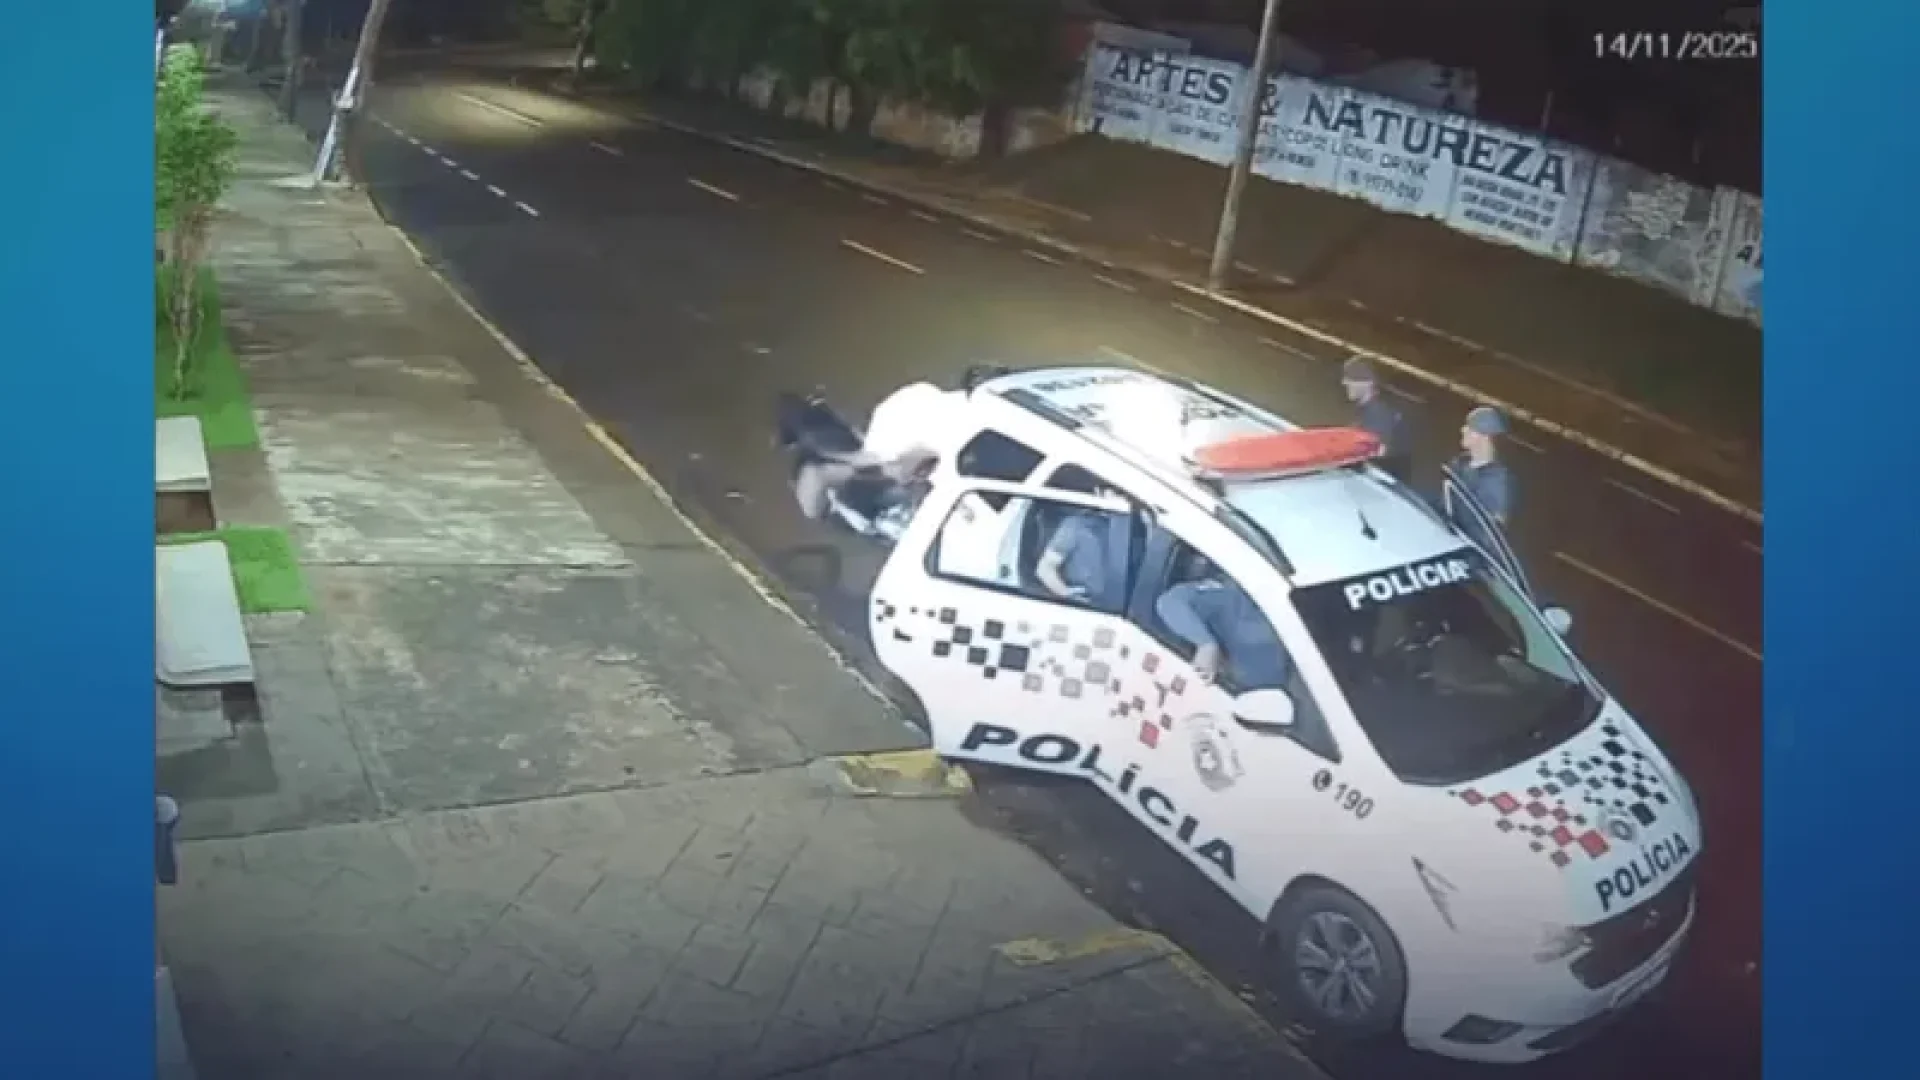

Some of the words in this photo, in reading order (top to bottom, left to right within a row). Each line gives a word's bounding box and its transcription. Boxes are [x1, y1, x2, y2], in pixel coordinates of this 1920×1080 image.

[1110, 51, 1231, 104] ARTES
[1303, 92, 1567, 194] NATUREZA
[1344, 557, 1470, 611] POLÍCIA
[962, 722, 1236, 881] POLÍCIA
[1334, 782, 1374, 820] 190
[1595, 831, 1691, 912] POLÍCIA
